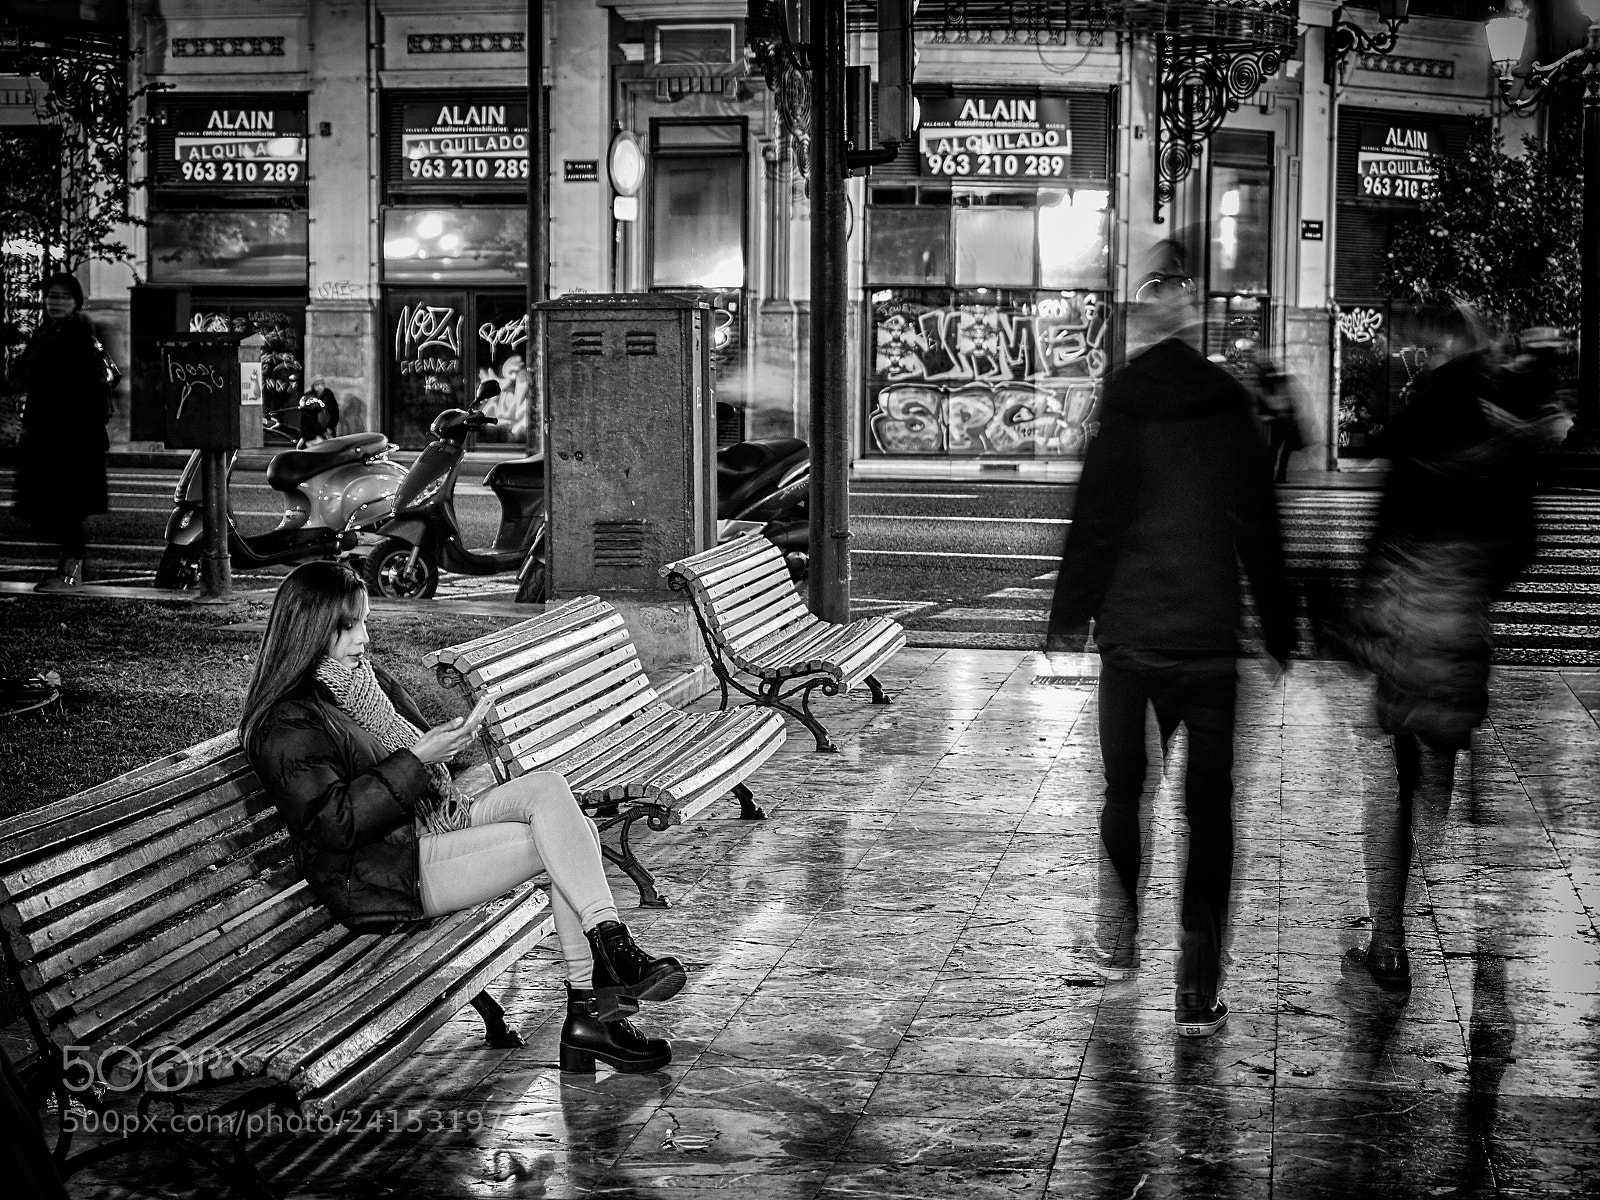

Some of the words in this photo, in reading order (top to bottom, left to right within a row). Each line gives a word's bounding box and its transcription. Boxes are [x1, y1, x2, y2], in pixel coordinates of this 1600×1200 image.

[207, 110, 274, 129] ALAIN
[436, 105, 505, 125] ALAIN
[957, 99, 1036, 120] ALAIN
[417, 134, 525, 156] ALQUILADO
[937, 130, 1060, 153] ALQUILADO
[1385, 127, 1428, 149] ALAIN
[182, 162, 217, 181] 963
[222, 162, 257, 181] 210
[263, 163, 299, 181] 289
[409, 159, 445, 179] 963
[451, 159, 488, 179] 210
[494, 159, 529, 179] 289
[928, 154, 970, 175] 963
[977, 155, 1018, 175] 210
[1024, 155, 1064, 176] 289
[1363, 176, 1391, 196] 963
[1394, 179, 1419, 198] 210
